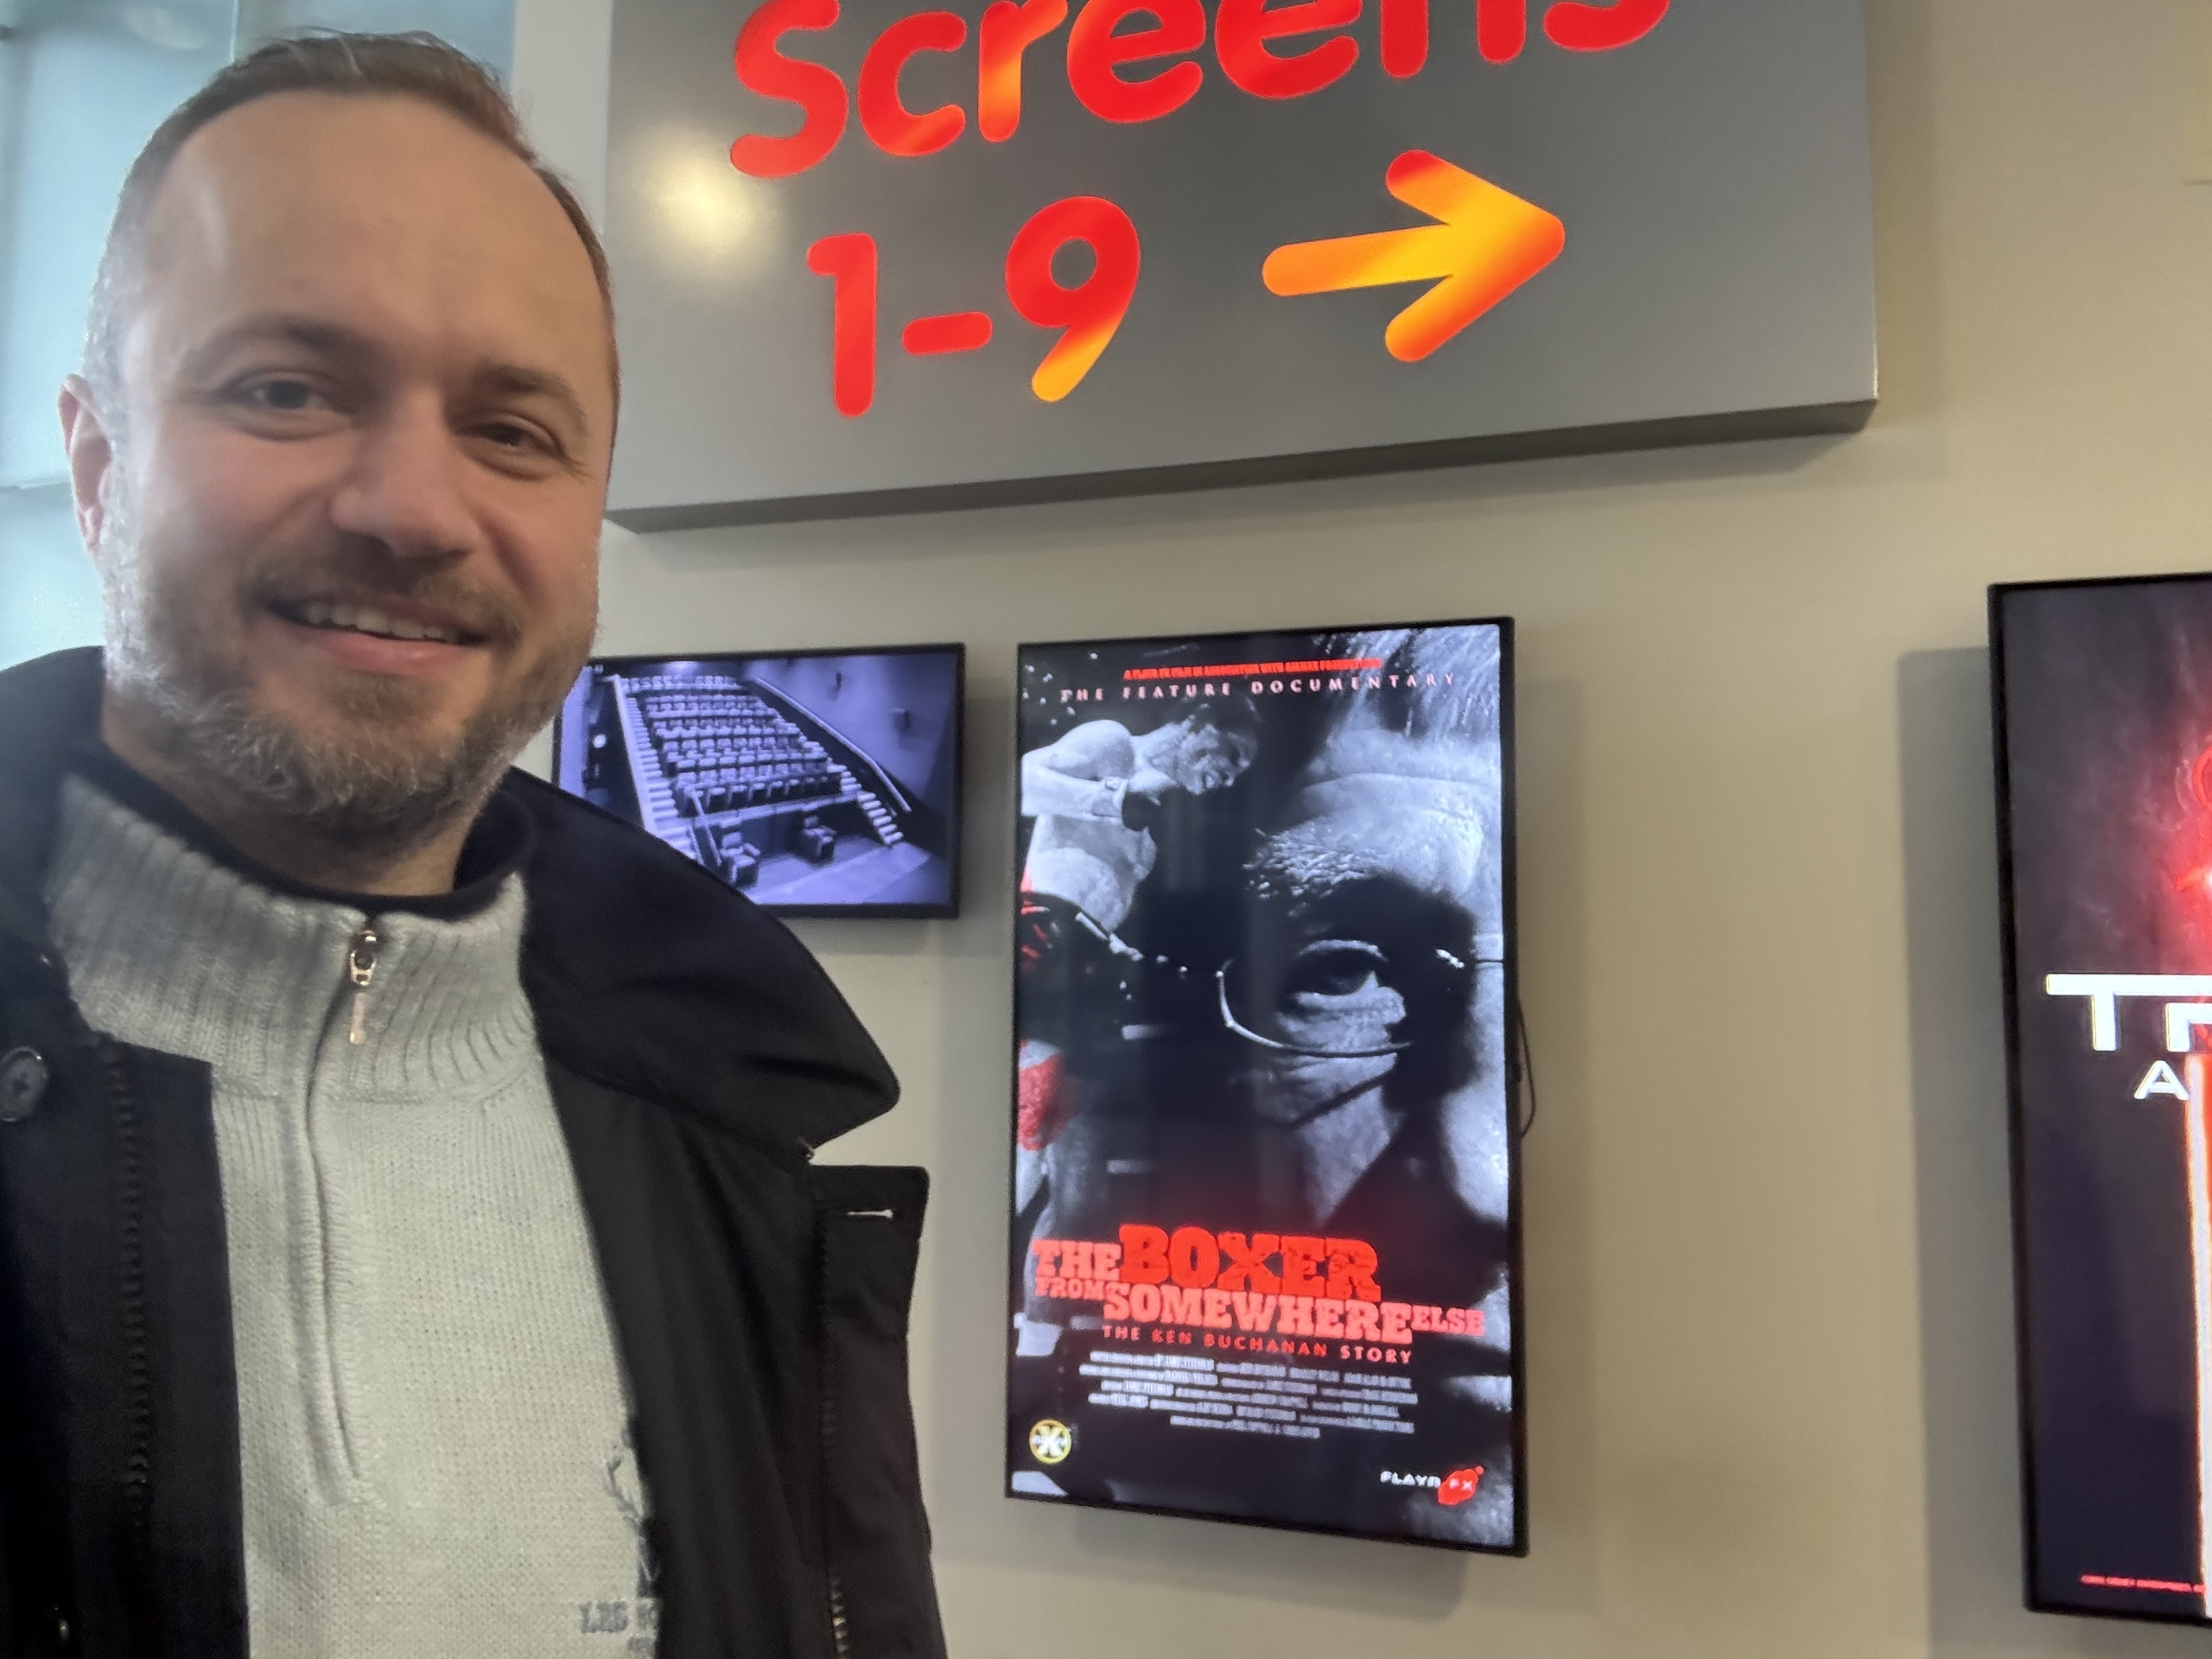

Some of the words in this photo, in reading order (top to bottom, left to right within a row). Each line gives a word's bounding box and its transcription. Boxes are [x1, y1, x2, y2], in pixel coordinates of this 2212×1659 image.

[805, 195, 1141, 416] 1-9
[1060, 688, 1103, 702] THE
[1122, 682, 1230, 700] FEATURE
[1251, 673, 1454, 695] DOCUMENTARY
[1033, 1239, 1122, 1281] THE
[1119, 1224, 1382, 1302] BOXER
[1035, 1277, 1104, 1300] FROM
[1103, 1282, 1413, 1344] SOMEWHERE
[1411, 1304, 1484, 1336] ELSE
[1102, 1325, 1141, 1340] THE
[1151, 1329, 1192, 1344] KEN
[1204, 1333, 1327, 1357] BUCHANAN
[1339, 1344, 1412, 1364] STORY
